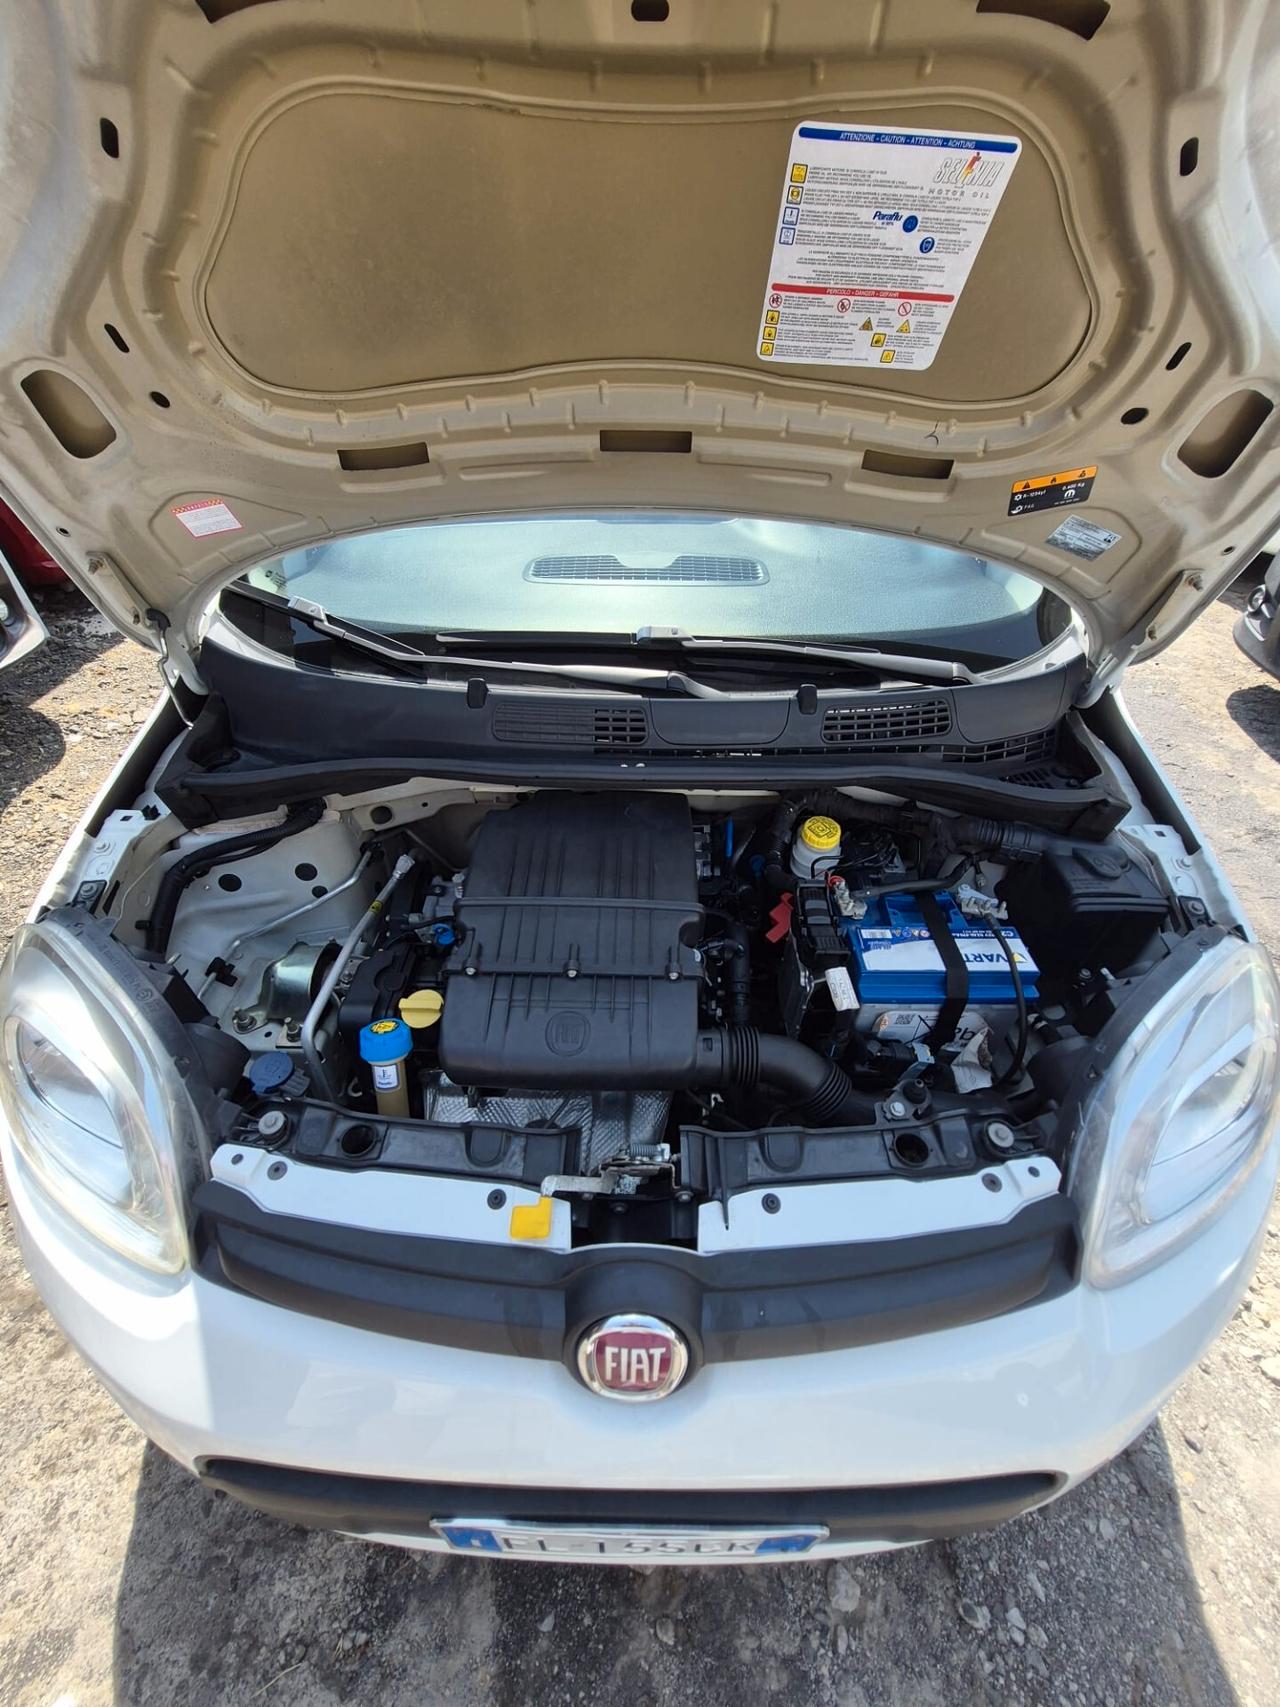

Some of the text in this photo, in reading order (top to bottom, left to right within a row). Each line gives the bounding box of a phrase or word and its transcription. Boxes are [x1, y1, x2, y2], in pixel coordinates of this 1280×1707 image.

[839, 132, 976, 148] ATTENZIONE CAUTION ATTENTION ACHTUNG
[928, 188, 965, 198] MOTOR
[872, 210, 904, 222] Paraflu
[826, 287, 851, 296] PERICOLO
[854, 289, 875, 297] DANGER
[964, 953, 1009, 963] VART
[604, 1346, 666, 1384] FIAT
